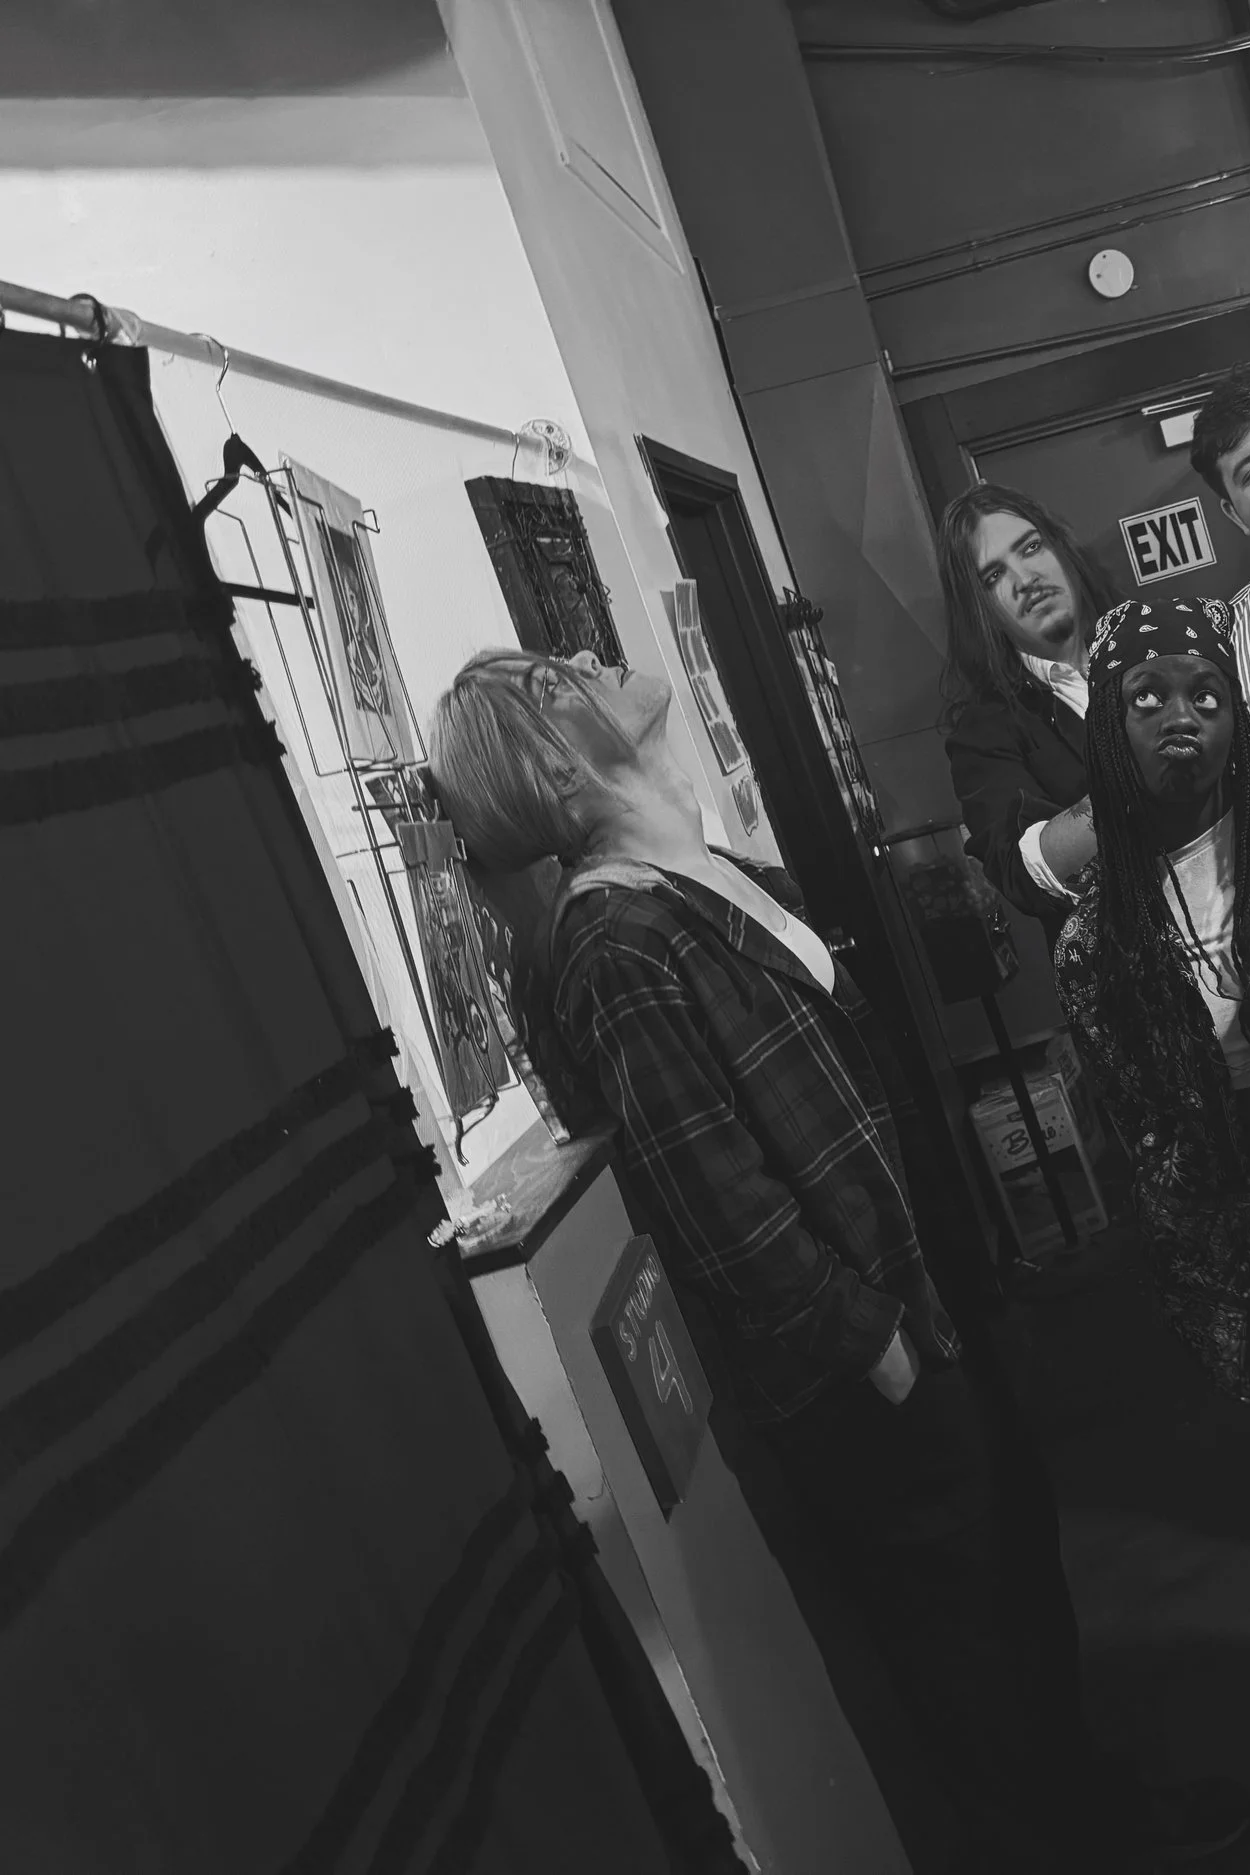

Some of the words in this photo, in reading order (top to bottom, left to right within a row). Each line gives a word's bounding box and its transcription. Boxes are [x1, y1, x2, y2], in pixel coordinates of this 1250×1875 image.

[1127, 507, 1203, 577] EXIT
[618, 1254, 661, 1362] STUDIO
[648, 1319, 693, 1415] 4
